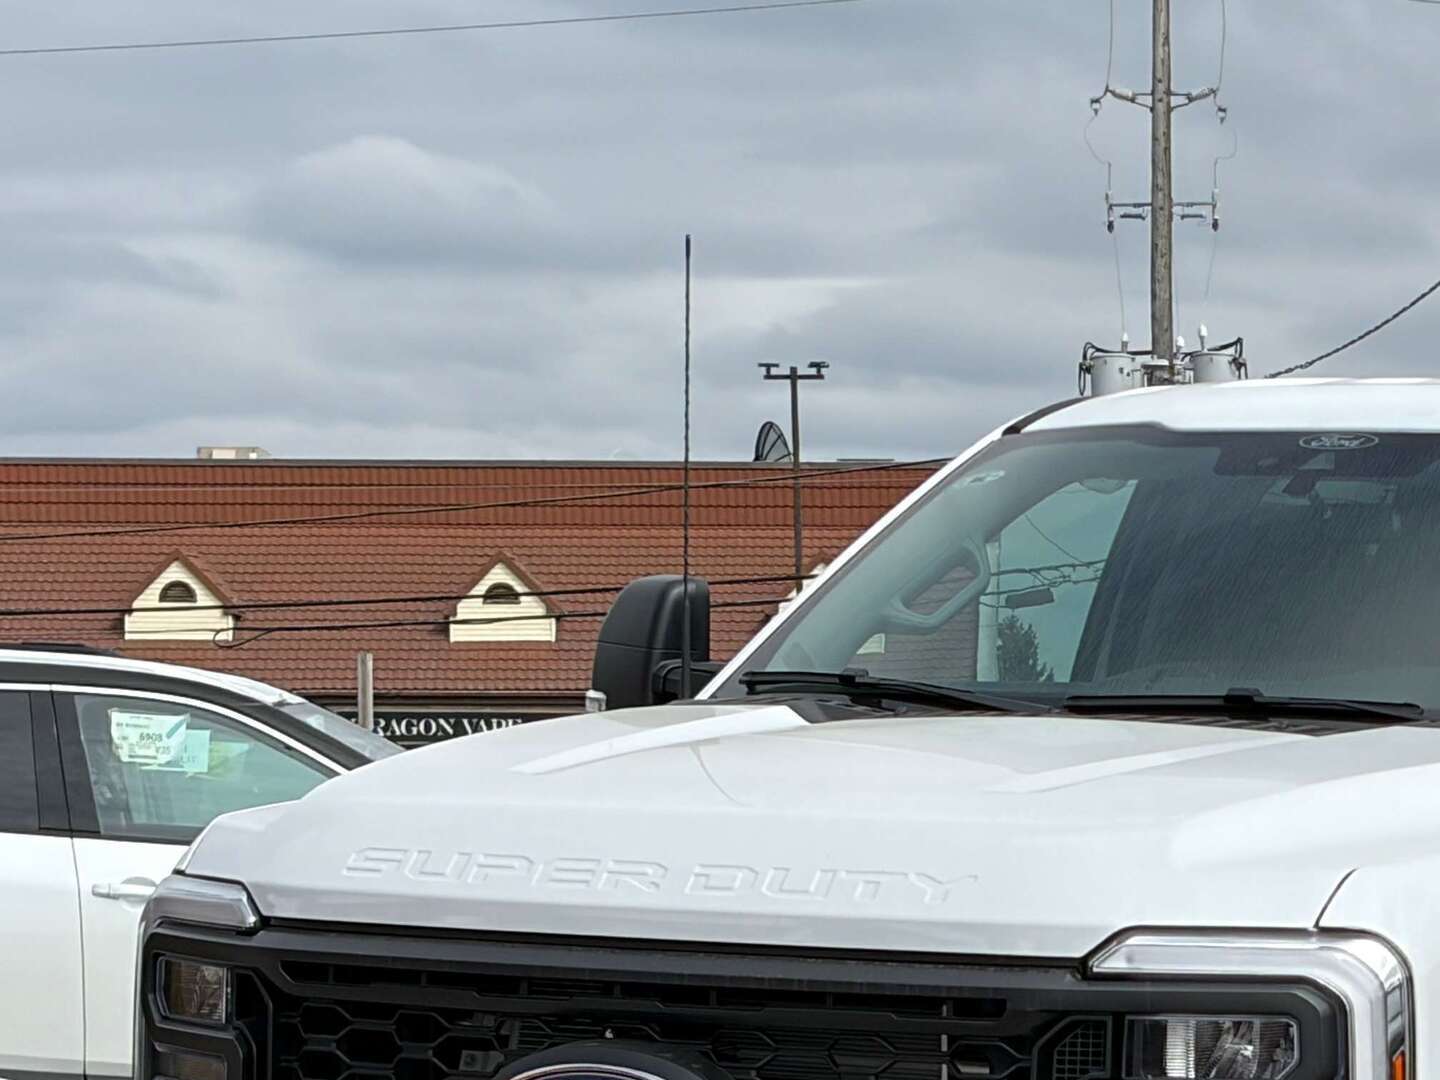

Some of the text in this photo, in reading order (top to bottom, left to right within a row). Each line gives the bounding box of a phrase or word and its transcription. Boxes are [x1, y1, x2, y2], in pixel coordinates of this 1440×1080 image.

[351, 717, 455, 737] RAGON
[342, 846, 979, 904] SUPER DUTY
